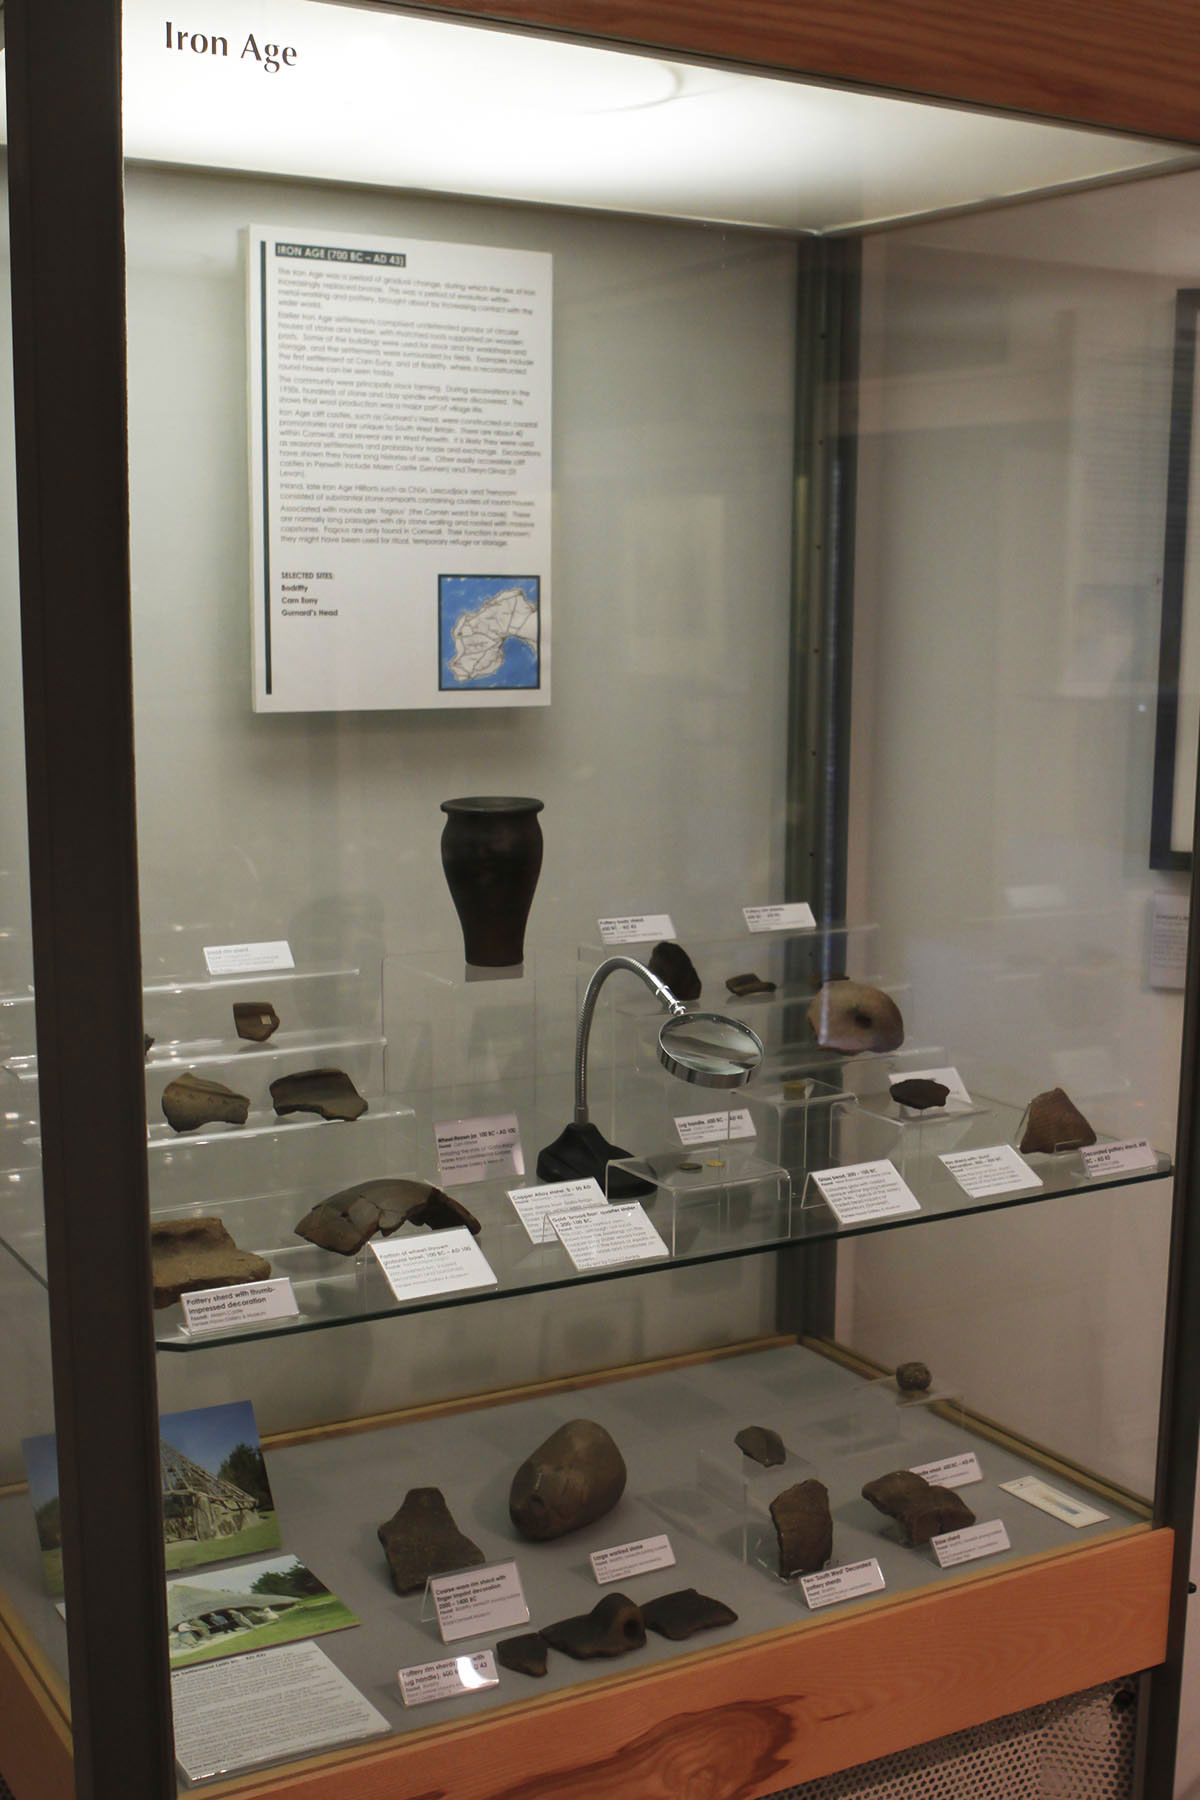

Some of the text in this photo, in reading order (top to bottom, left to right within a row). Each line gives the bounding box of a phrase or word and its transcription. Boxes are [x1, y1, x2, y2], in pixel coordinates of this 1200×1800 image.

[165, 21, 297, 73] Iron Age
[278, 245, 302, 256] IRON
[304, 247, 325, 258] AGE
[373, 254, 386, 263] AD
[281, 572, 314, 580] SELECTED
[186, 1296, 212, 1306] Pottery
[213, 1292, 233, 1302] sherd
[235, 1289, 249, 1298] with
[188, 1297, 267, 1314] impressed decoration
